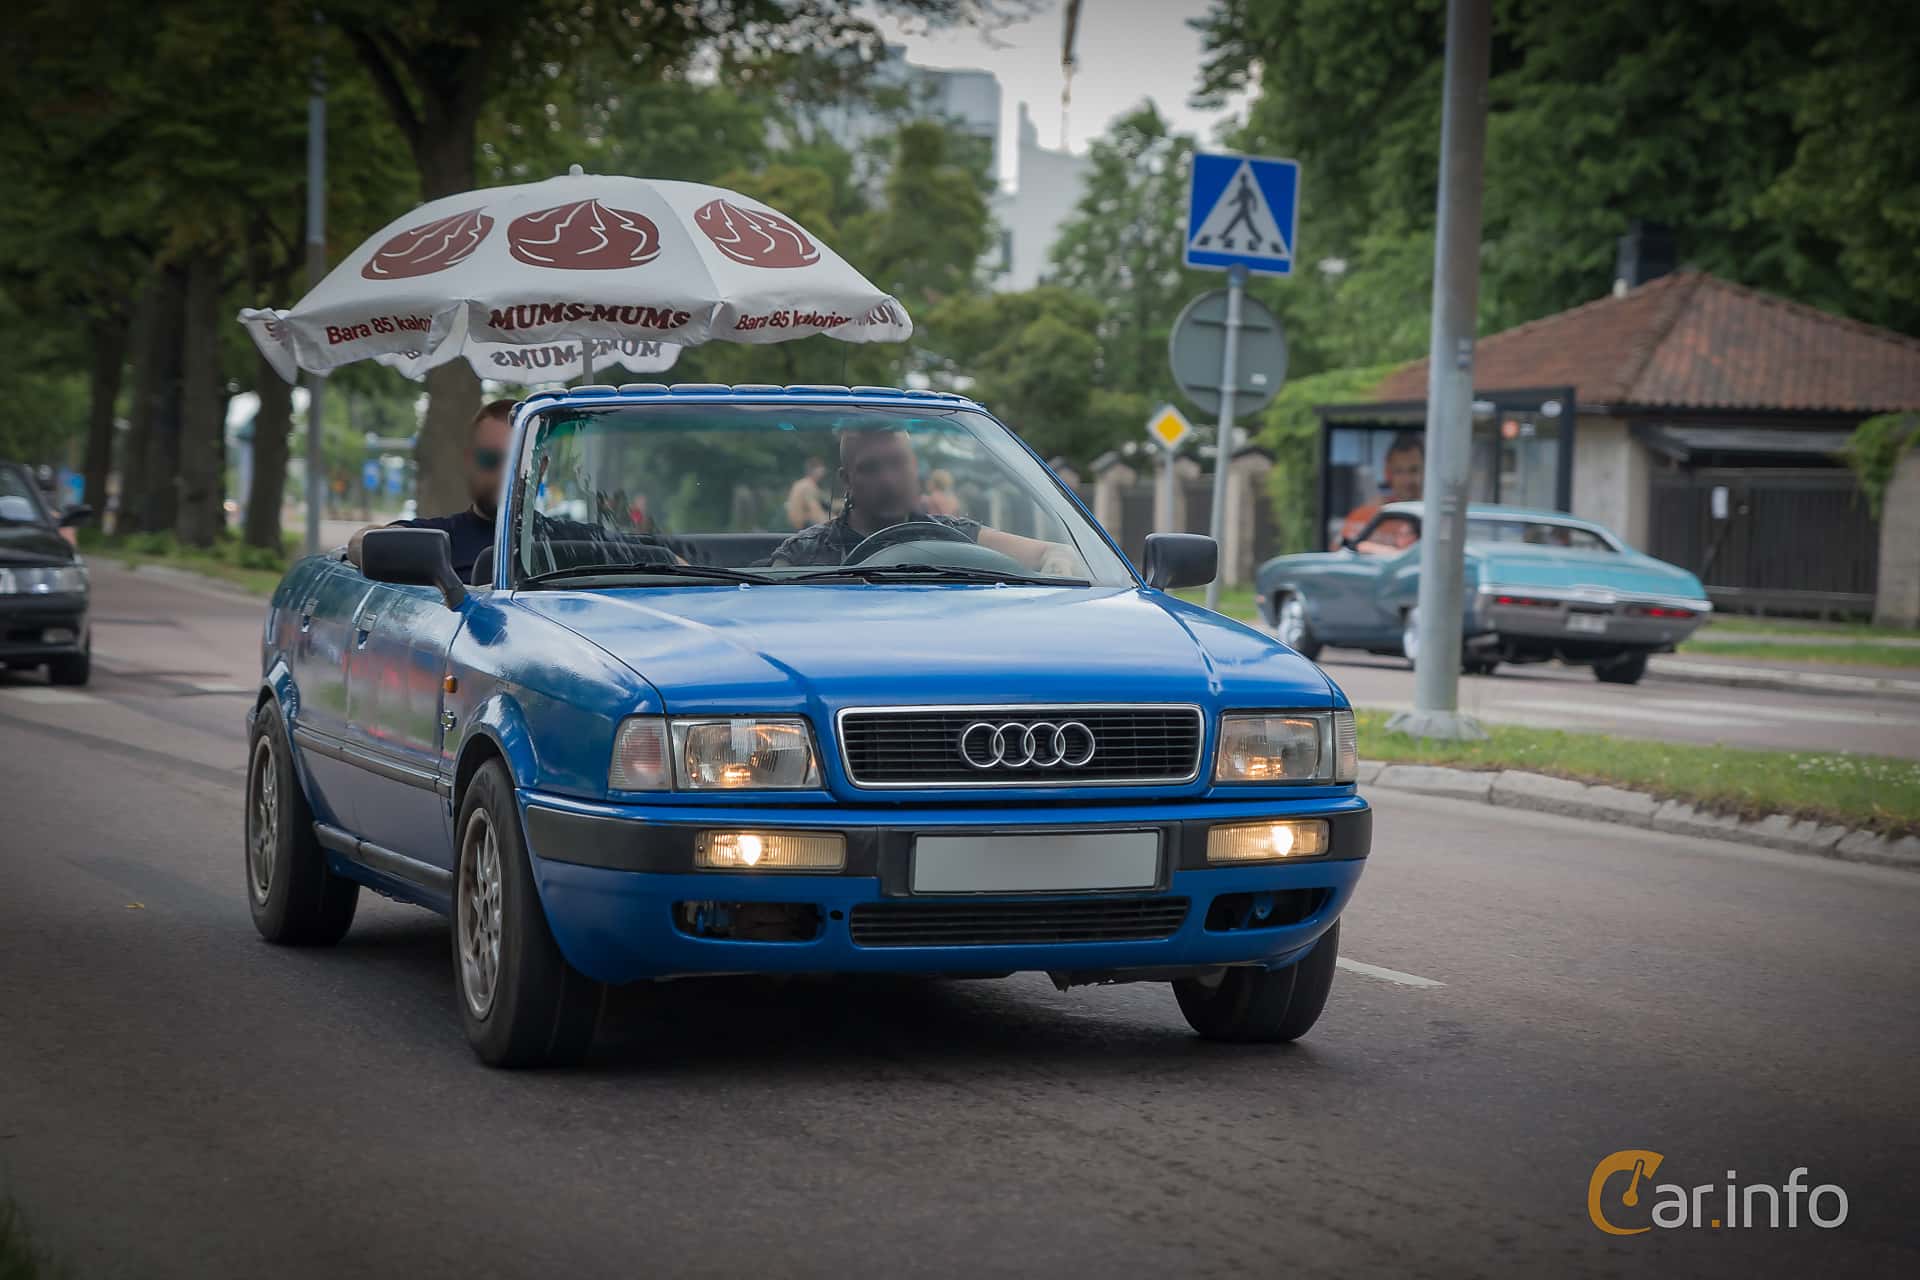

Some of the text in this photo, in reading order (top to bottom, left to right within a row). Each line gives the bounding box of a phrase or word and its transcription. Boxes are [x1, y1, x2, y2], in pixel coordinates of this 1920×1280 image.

[487, 302, 692, 331] MUMS-MUMS
[768, 310, 790, 328] 85
[326, 323, 372, 345] Bara
[370, 317, 395, 334] 85
